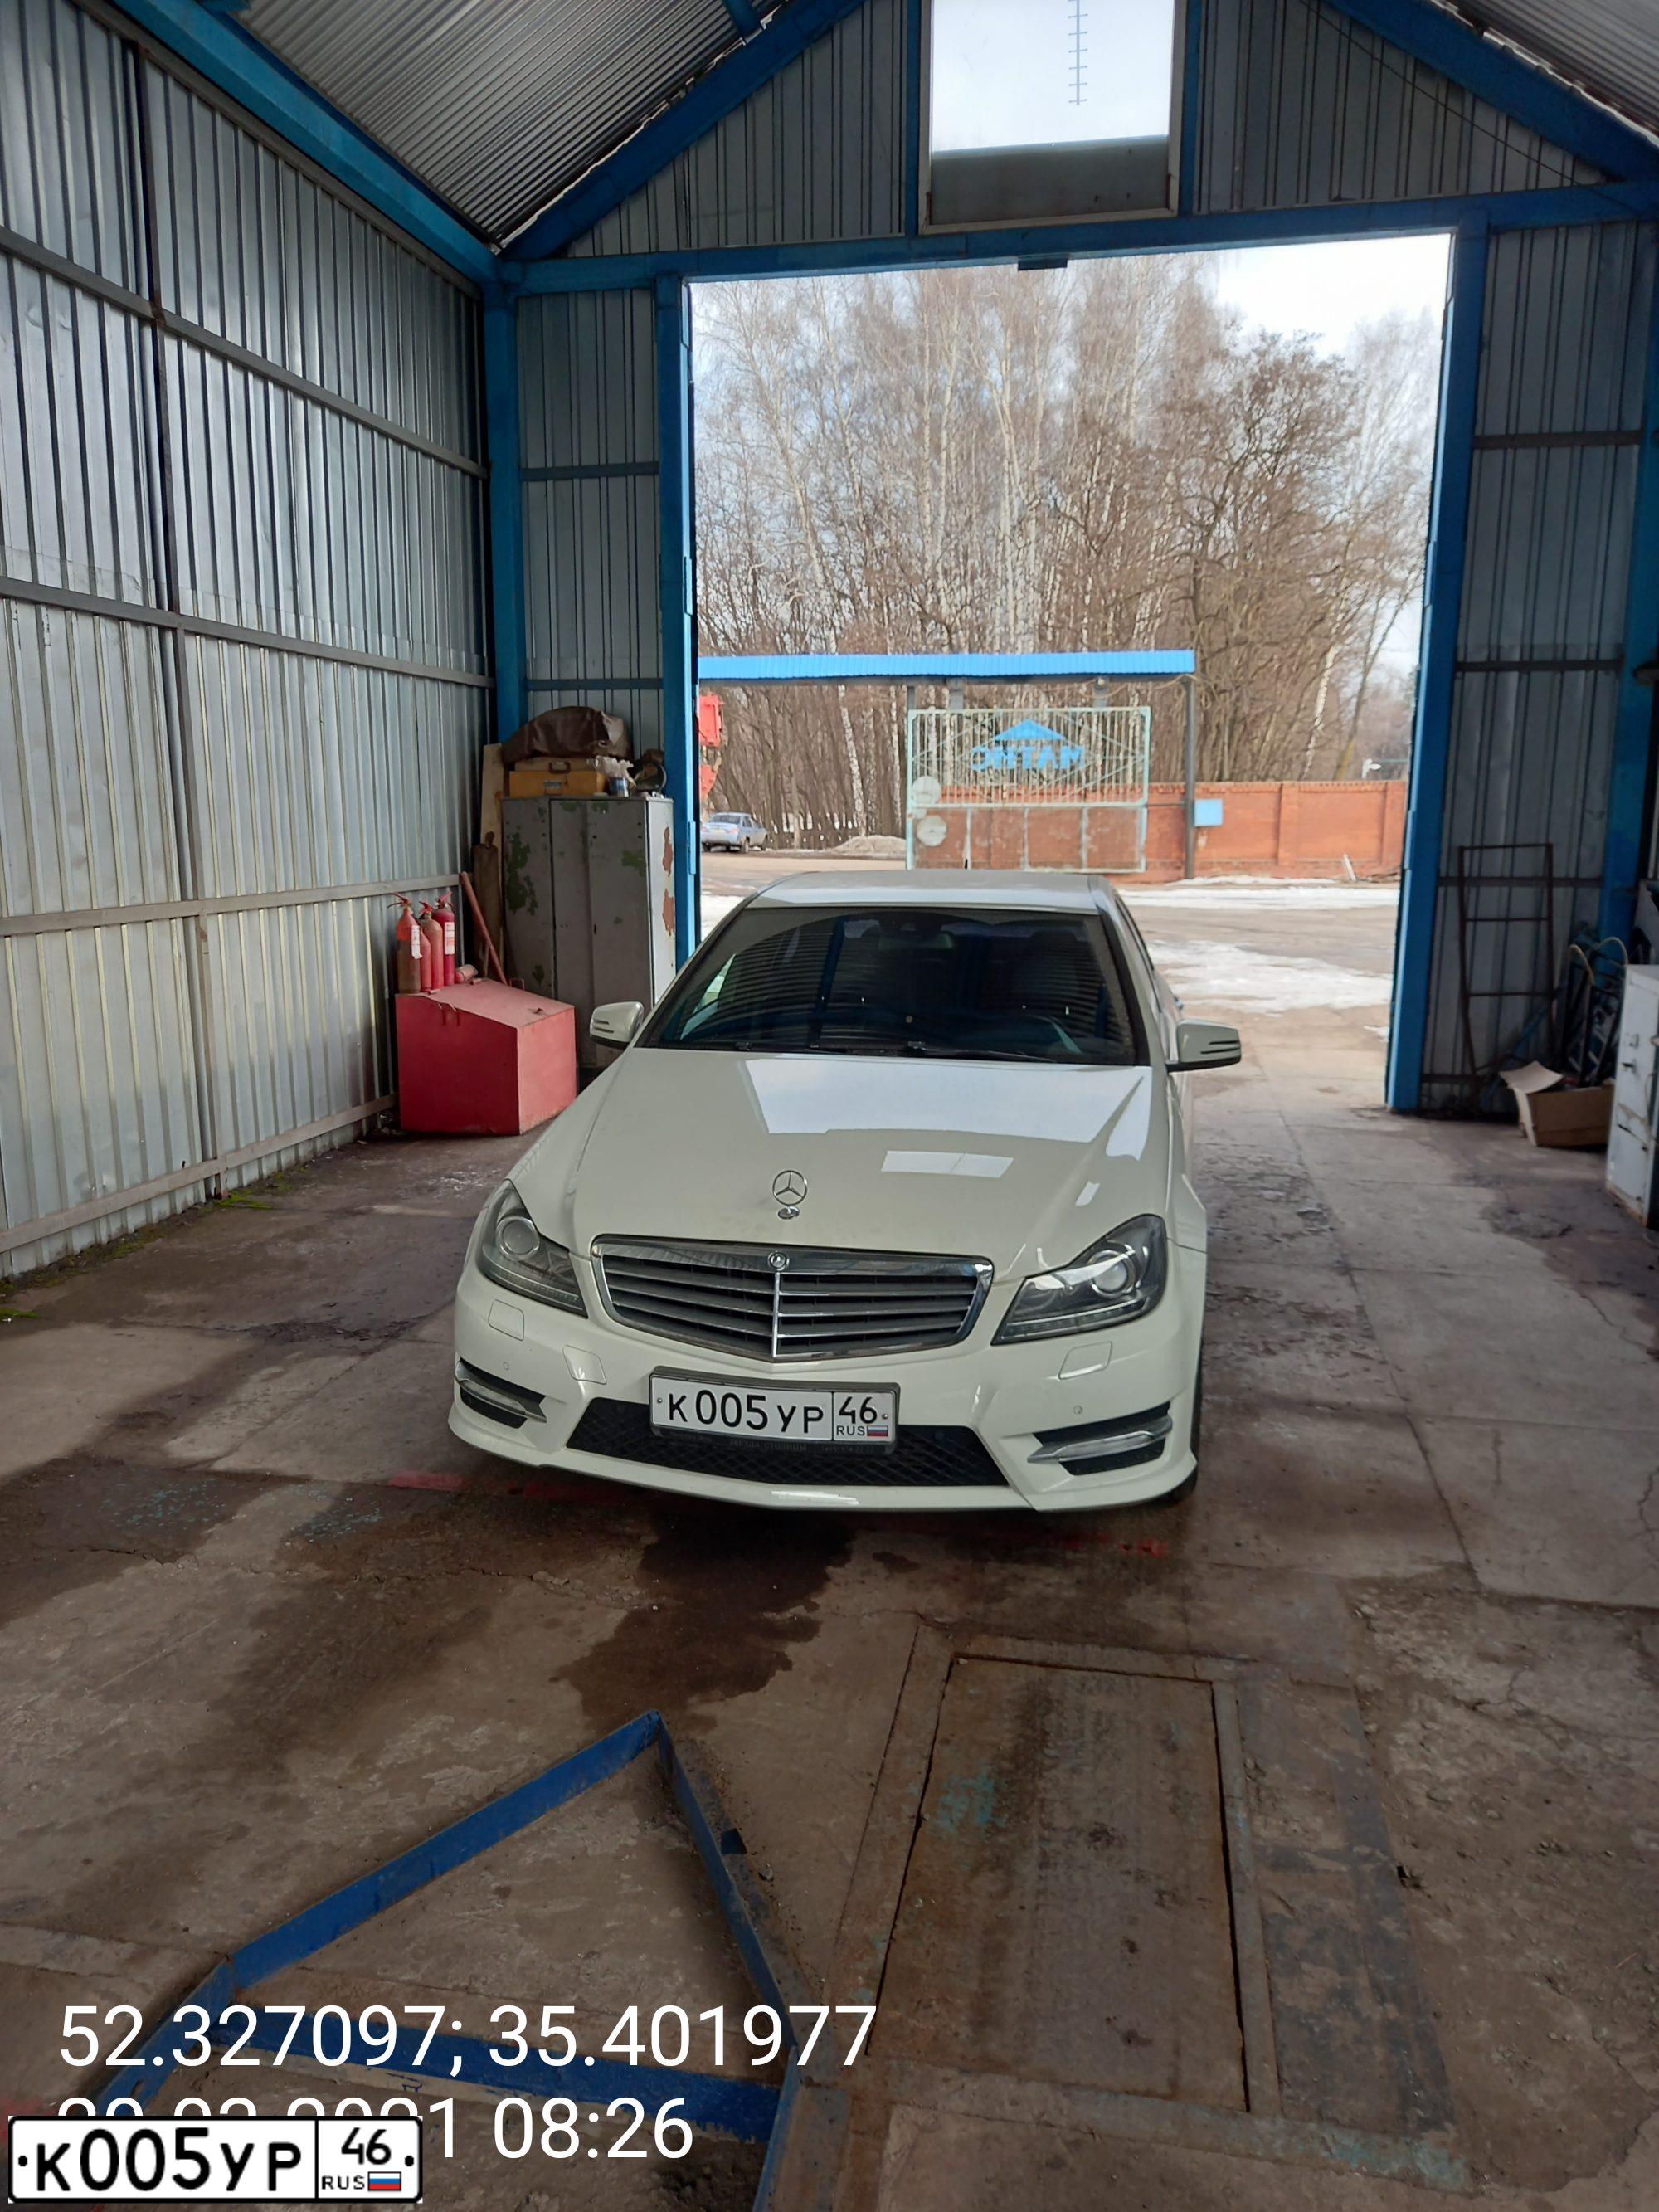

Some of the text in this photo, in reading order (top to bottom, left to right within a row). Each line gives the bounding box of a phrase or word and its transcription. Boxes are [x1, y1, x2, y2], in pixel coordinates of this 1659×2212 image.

[668, 1389, 878, 1434] К005УР 46
[835, 1425, 866, 1436] RUS
